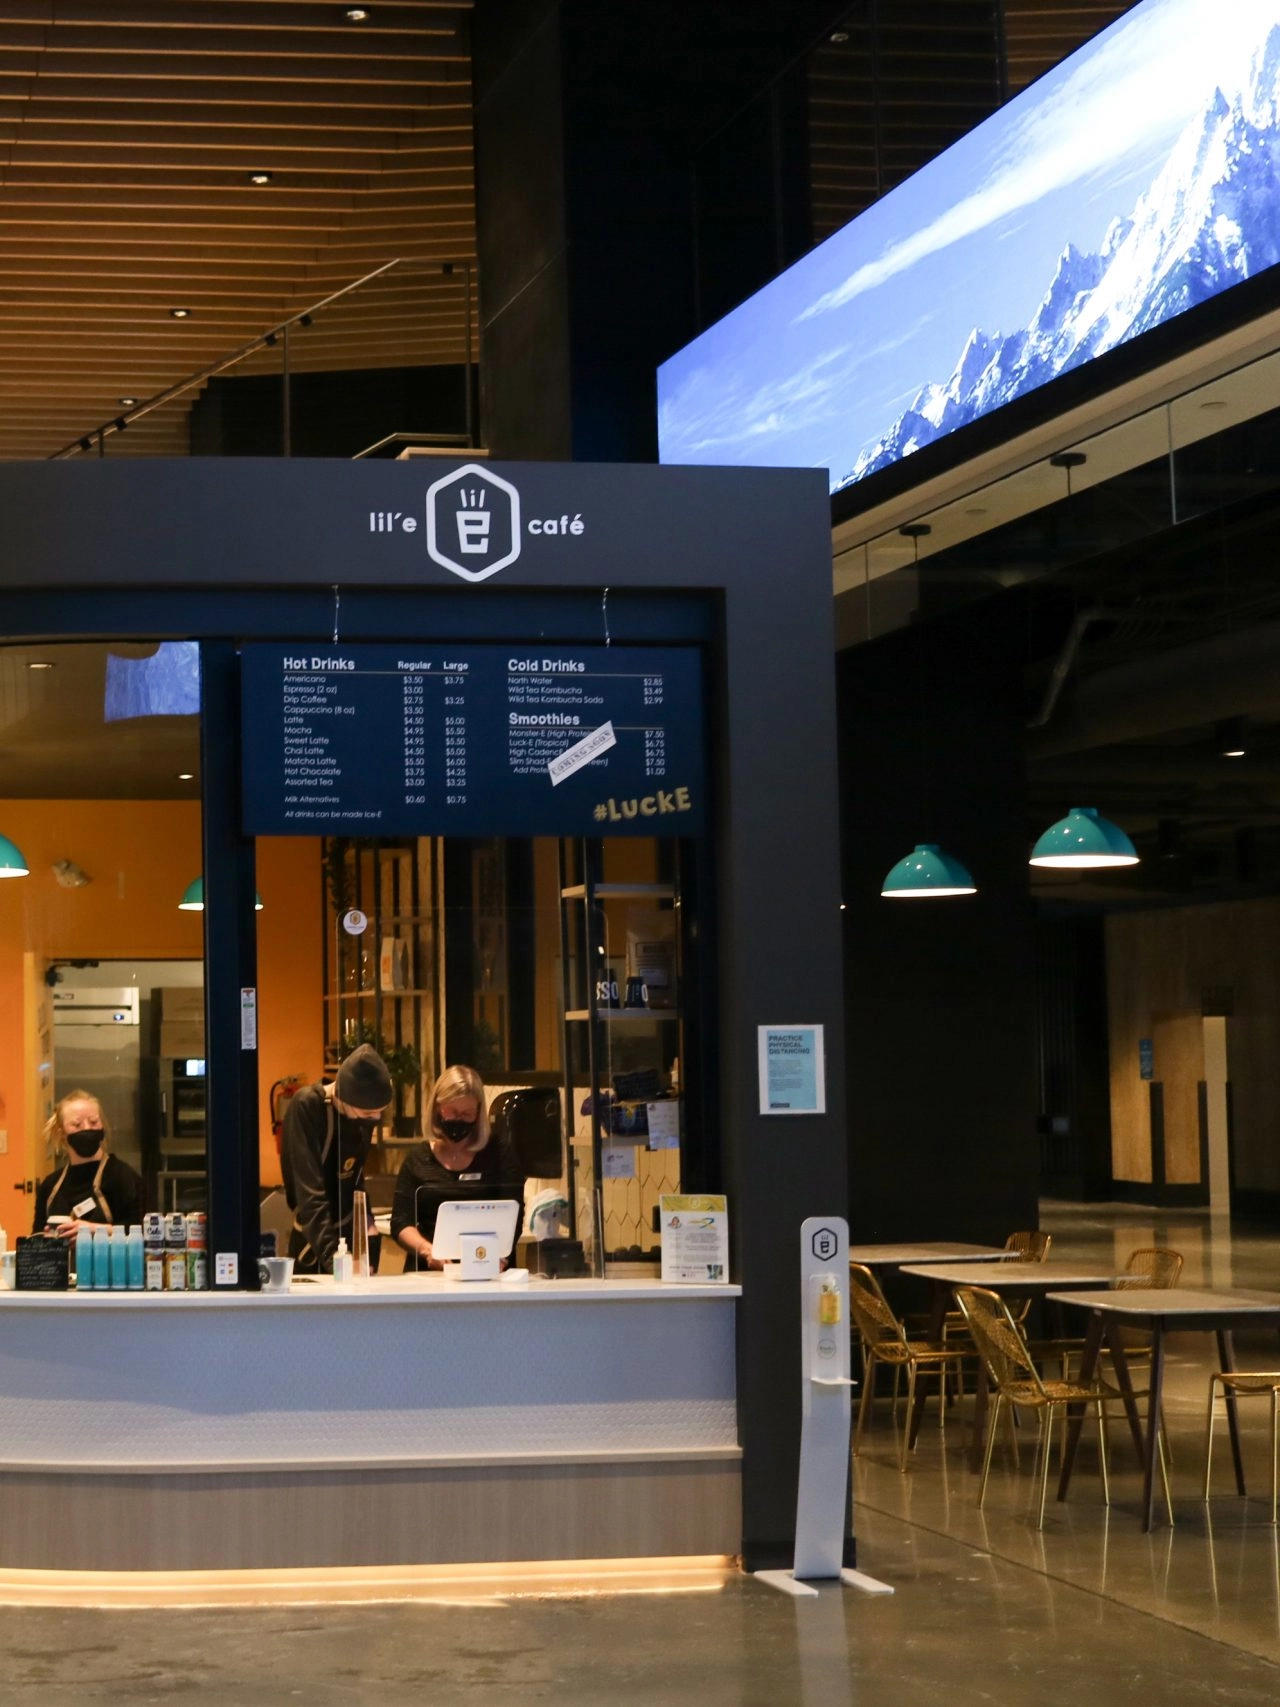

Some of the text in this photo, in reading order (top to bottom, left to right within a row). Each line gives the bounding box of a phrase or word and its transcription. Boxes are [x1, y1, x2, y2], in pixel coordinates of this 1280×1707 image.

[528, 513, 584, 536] café
[283, 657, 469, 671] Hot Drinks Regular Large
[508, 659, 585, 673] Cold Drinks
[284, 675, 326, 683] Americano
[508, 676, 529, 685] North
[530, 677, 553, 685] Water
[284, 686, 315, 694] Espresso
[317, 686, 325, 695] (2
[326, 686, 337, 695] oz)
[508, 686, 525, 694] Wild
[526, 686, 540, 694] Tea
[541, 686, 583, 695] Kombucha
[284, 696, 299, 705] Drip
[301, 696, 327, 704] Coffee
[508, 696, 525, 704] Wild
[526, 696, 540, 704] Tea
[541, 696, 583, 704] Kombucha
[584, 696, 604, 704] Soda
[284, 706, 332, 715] Cappuccino
[344, 706, 355, 715] oz)
[284, 716, 304, 724] Latte
[509, 712, 580, 726] Smoothies
[284, 726, 312, 734] Mocha
[509, 729, 546, 737] Monster-E
[547, 730, 567, 739] (High
[284, 737, 308, 745] Sweet
[309, 737, 330, 745] Latte
[509, 739, 534, 747] Luck-E
[534, 739, 569, 748] (Tropical)
[284, 747, 303, 755] Chai
[304, 747, 325, 755] Latte
[284, 757, 315, 765] Matcha
[317, 757, 337, 765] Latte
[509, 757, 524, 765] Slim
[300, 768, 341, 776] Chocolate
[284, 778, 318, 786] Assorted
[319, 778, 333, 786] Tea
[284, 795, 298, 803] Milk
[299, 795, 340, 804] Alternatives
[284, 810, 293, 818] All
[294, 810, 314, 818] drinks
[331, 810, 340, 818] be
[342, 810, 363, 818] made
